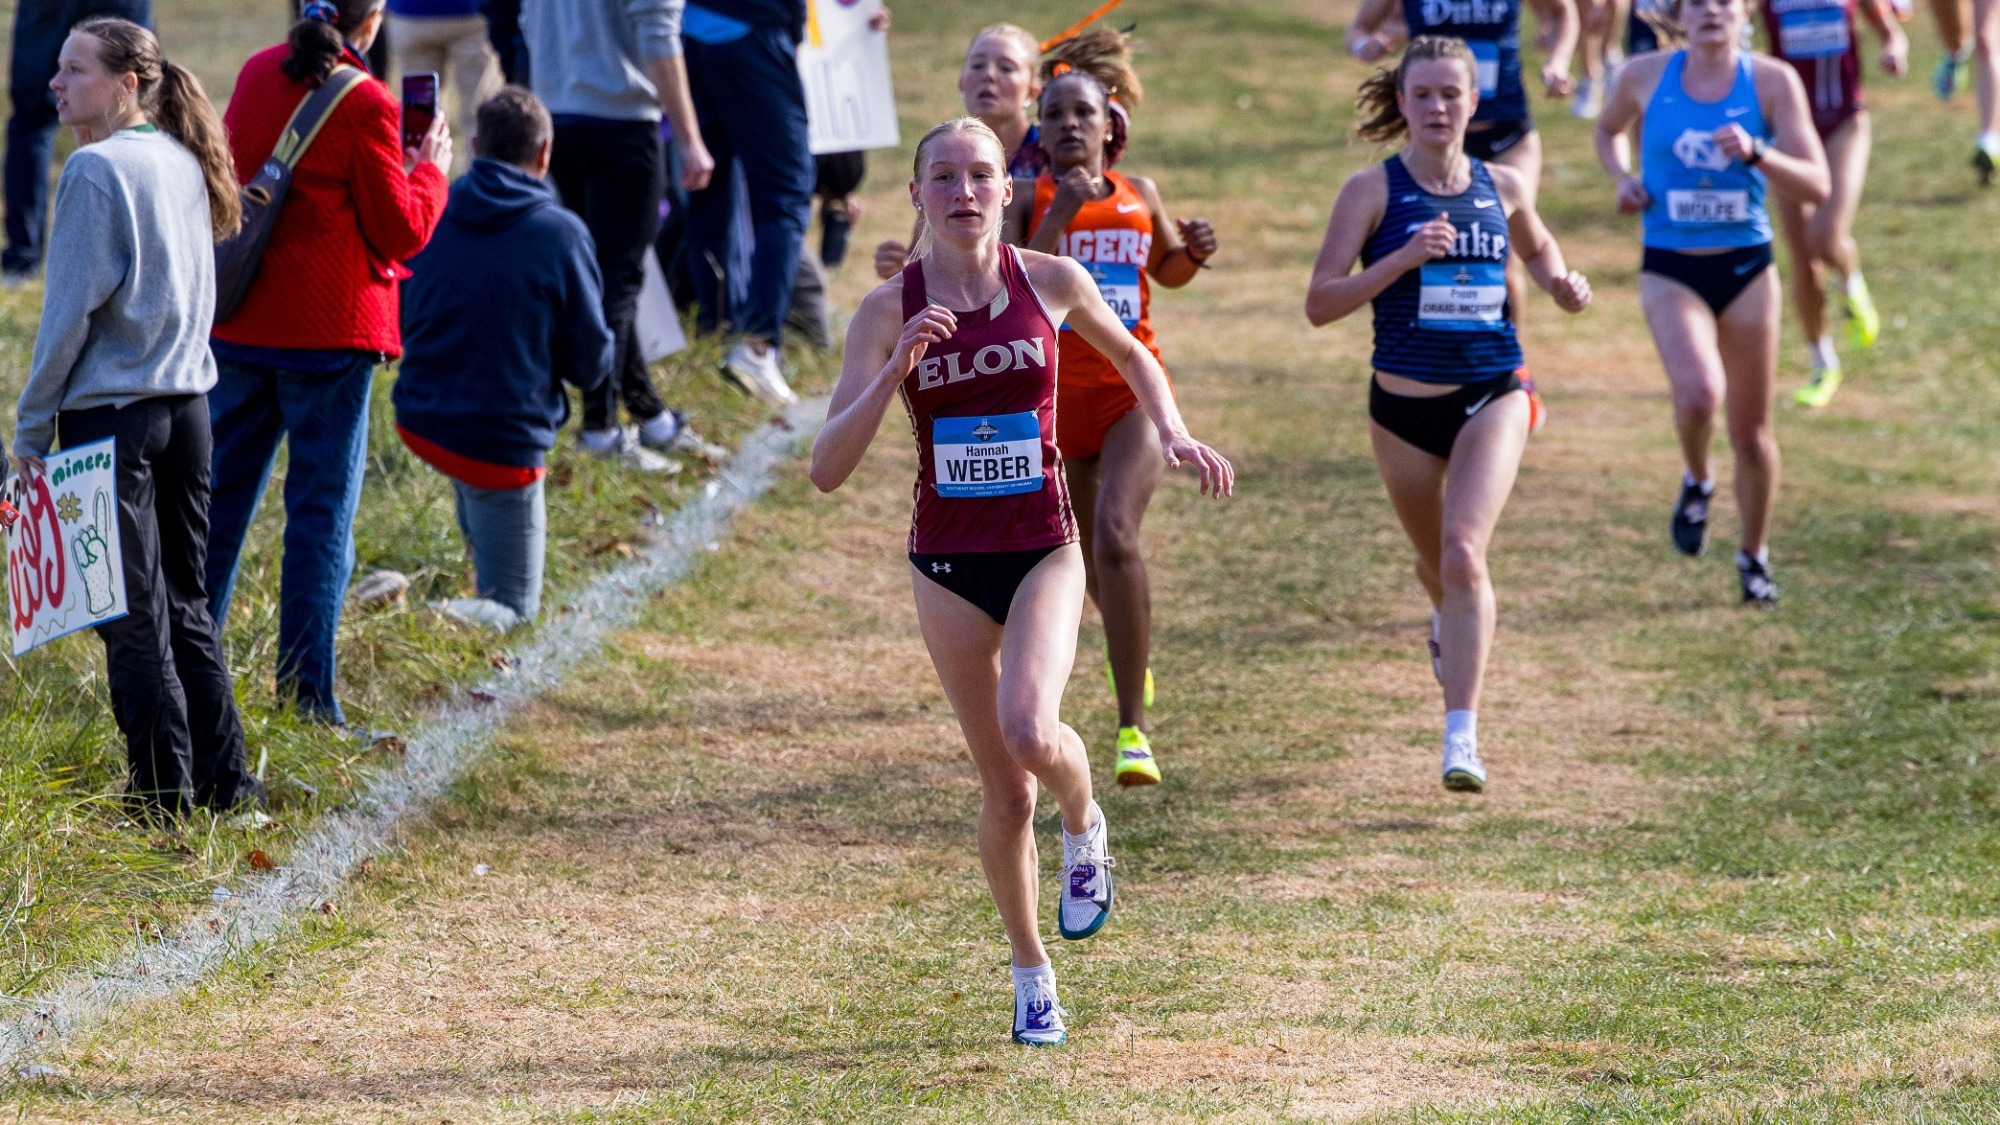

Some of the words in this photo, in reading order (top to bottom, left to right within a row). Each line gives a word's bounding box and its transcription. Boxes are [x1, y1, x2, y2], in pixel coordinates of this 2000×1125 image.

[1058, 228, 1152, 268] IGERS
[916, 337, 1046, 391] ELON
[966, 444, 1009, 457] Hannah
[52, 452, 111, 487] niners
[945, 455, 1031, 482] WEBER
